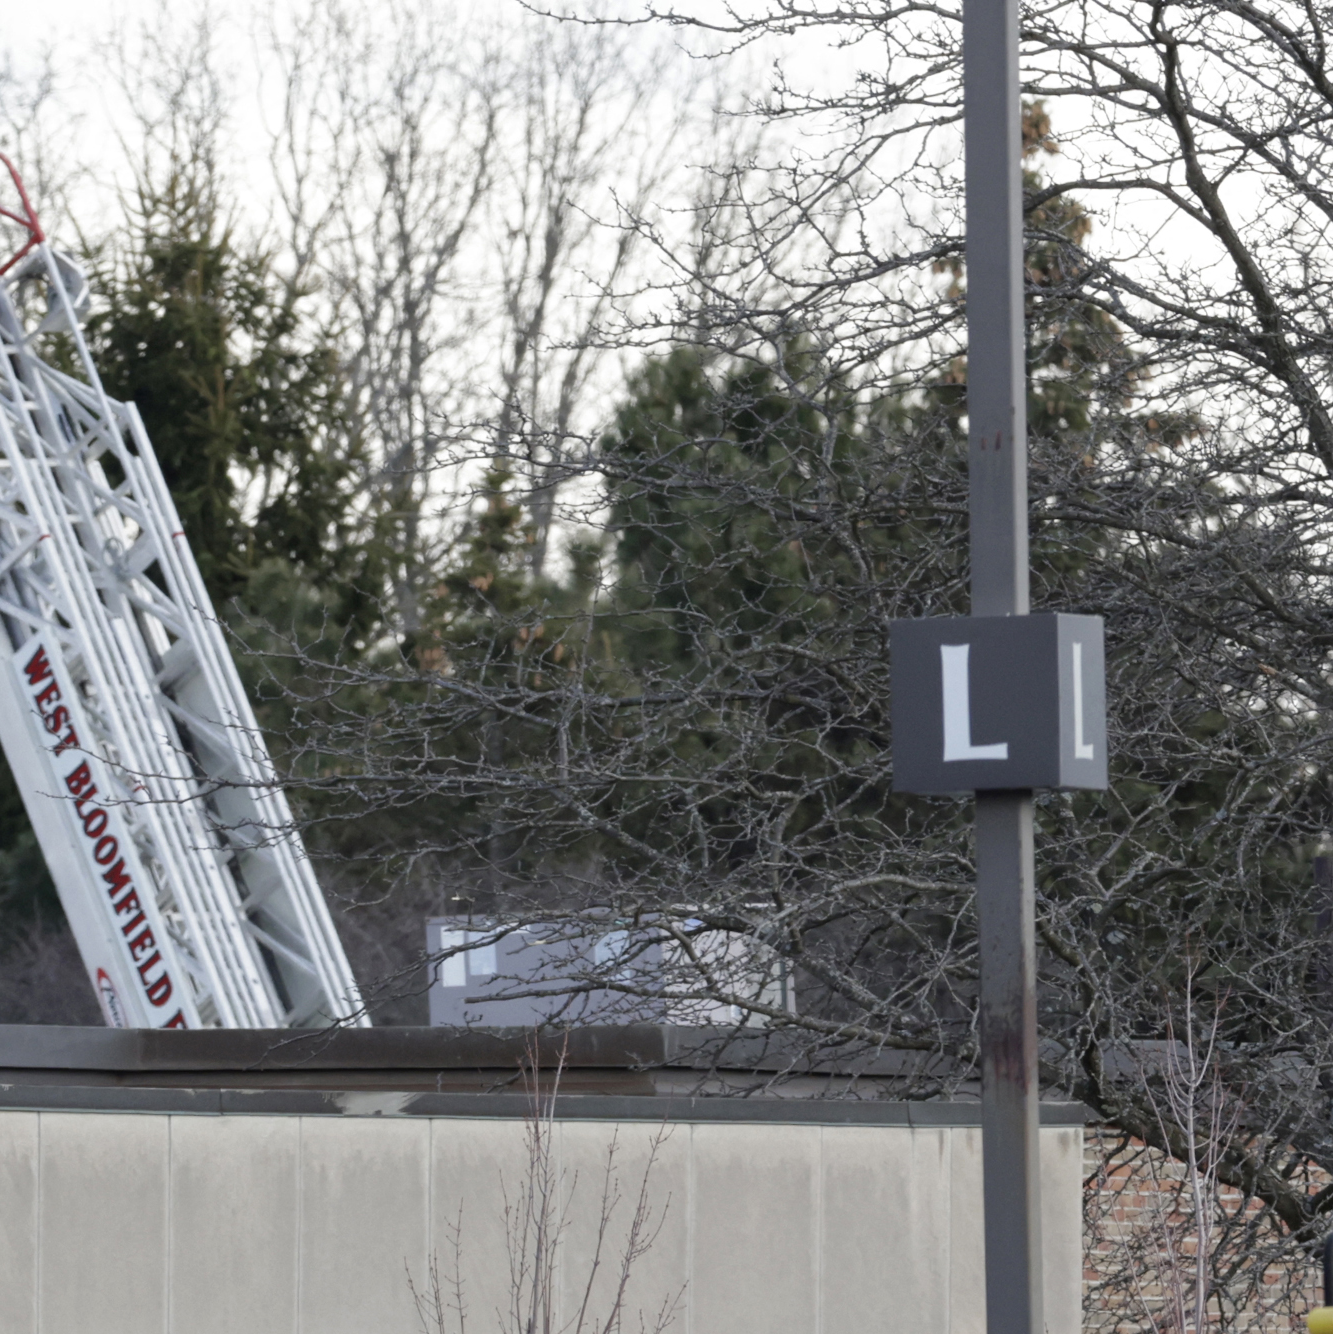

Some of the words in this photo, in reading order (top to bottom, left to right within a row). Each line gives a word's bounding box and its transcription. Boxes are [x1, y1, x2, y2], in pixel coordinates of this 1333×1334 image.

[940, 643, 1008, 762] L
[1072, 642, 1094, 760] L
[23, 643, 80, 758] WEST
[65, 758, 173, 1008] BLOOMFIELD
